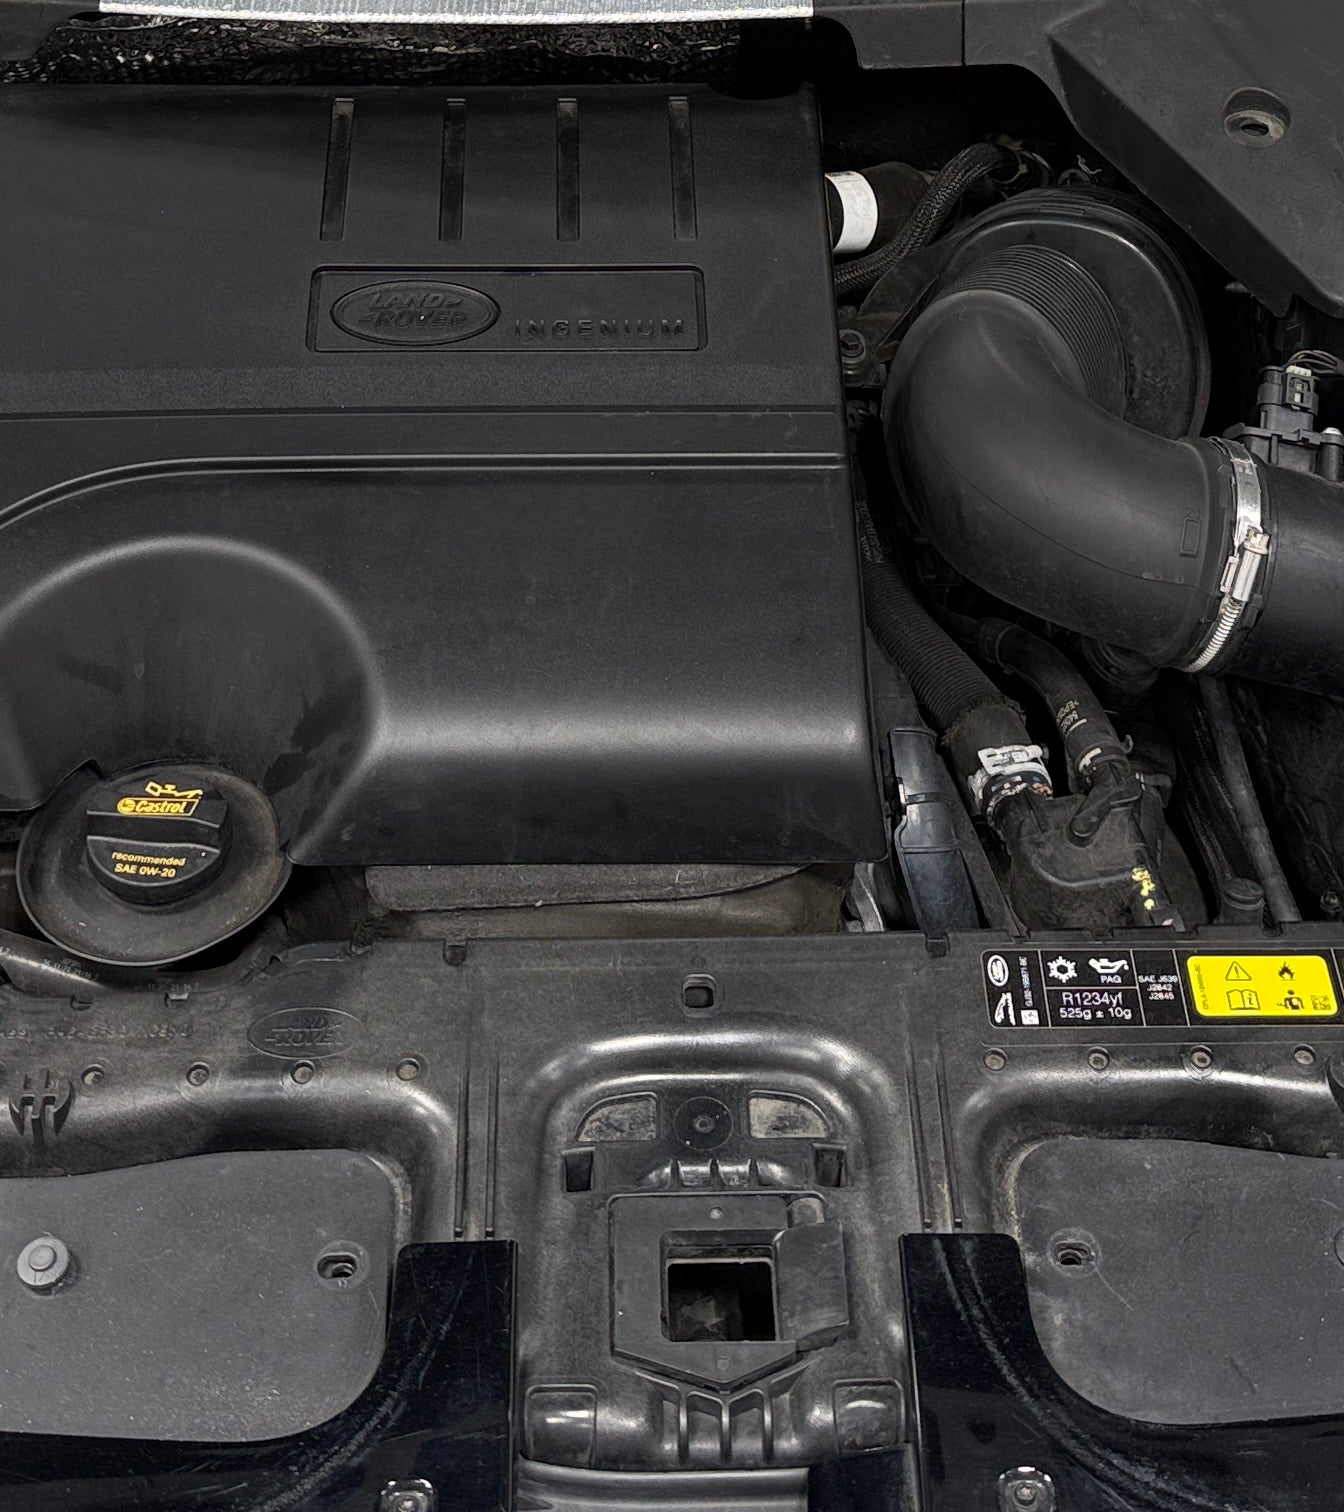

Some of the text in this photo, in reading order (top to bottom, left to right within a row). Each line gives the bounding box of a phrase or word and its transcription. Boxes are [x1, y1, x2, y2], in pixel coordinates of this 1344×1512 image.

[369, 292, 448, 310] LAND
[372, 309, 468, 329] ROVER
[514, 319, 685, 337] INGENIUM
[135, 800, 188, 814] Castrol
[111, 851, 187, 866] recommended
[114, 863, 176, 878] SAE 0W-20
[1100, 975, 1122, 984] PAG
[1062, 991, 1123, 1007] R1234yf
[1059, 1007, 1092, 1020] 525g
[1108, 1007, 1132, 1020] 10g
